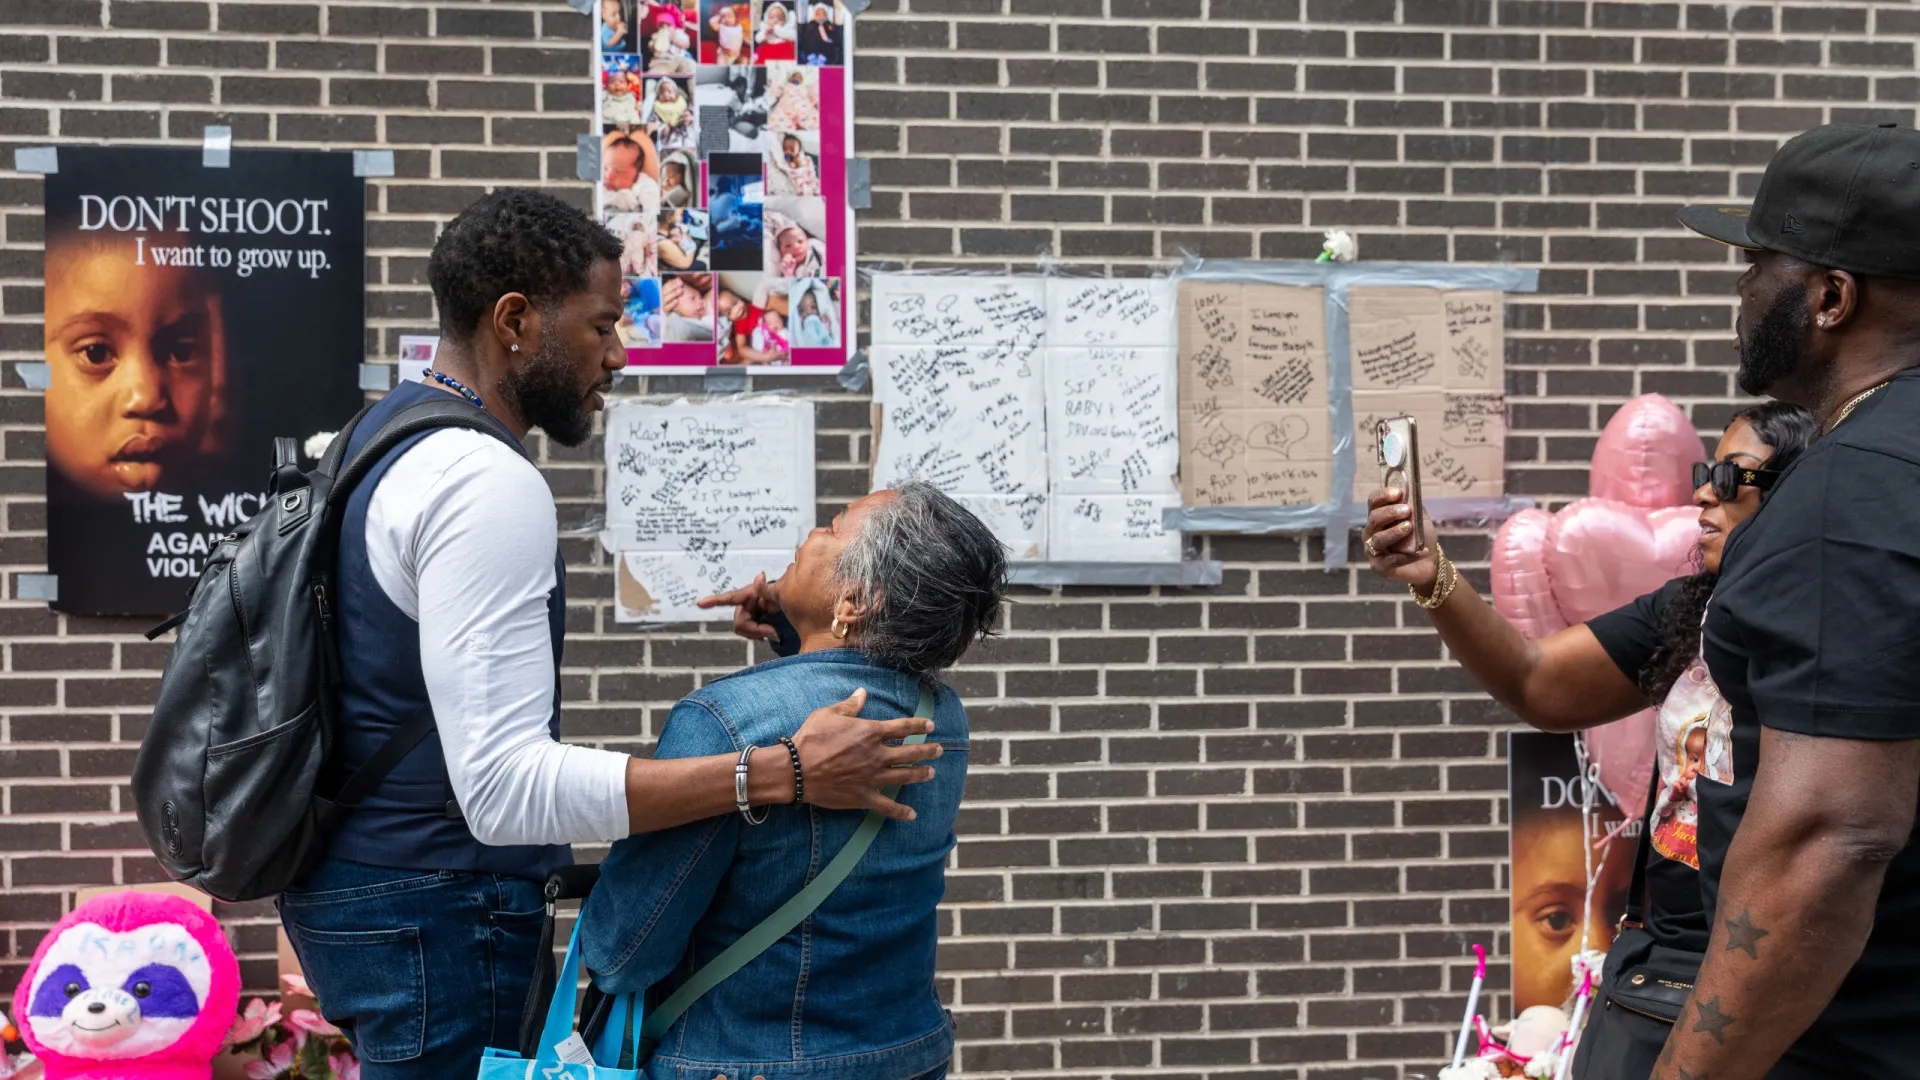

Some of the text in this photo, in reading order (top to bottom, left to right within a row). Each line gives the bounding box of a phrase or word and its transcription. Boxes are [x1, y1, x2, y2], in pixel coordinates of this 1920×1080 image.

[78, 195, 332, 236] DON'T SHOOT.
[135, 237, 332, 279] I want to grow up.
[123, 491, 188, 523] THE
[147, 533, 225, 555] AGAI
[147, 558, 207, 577] VIOL
[1540, 776, 1608, 809] DO
[1592, 812, 1643, 838] I wan
